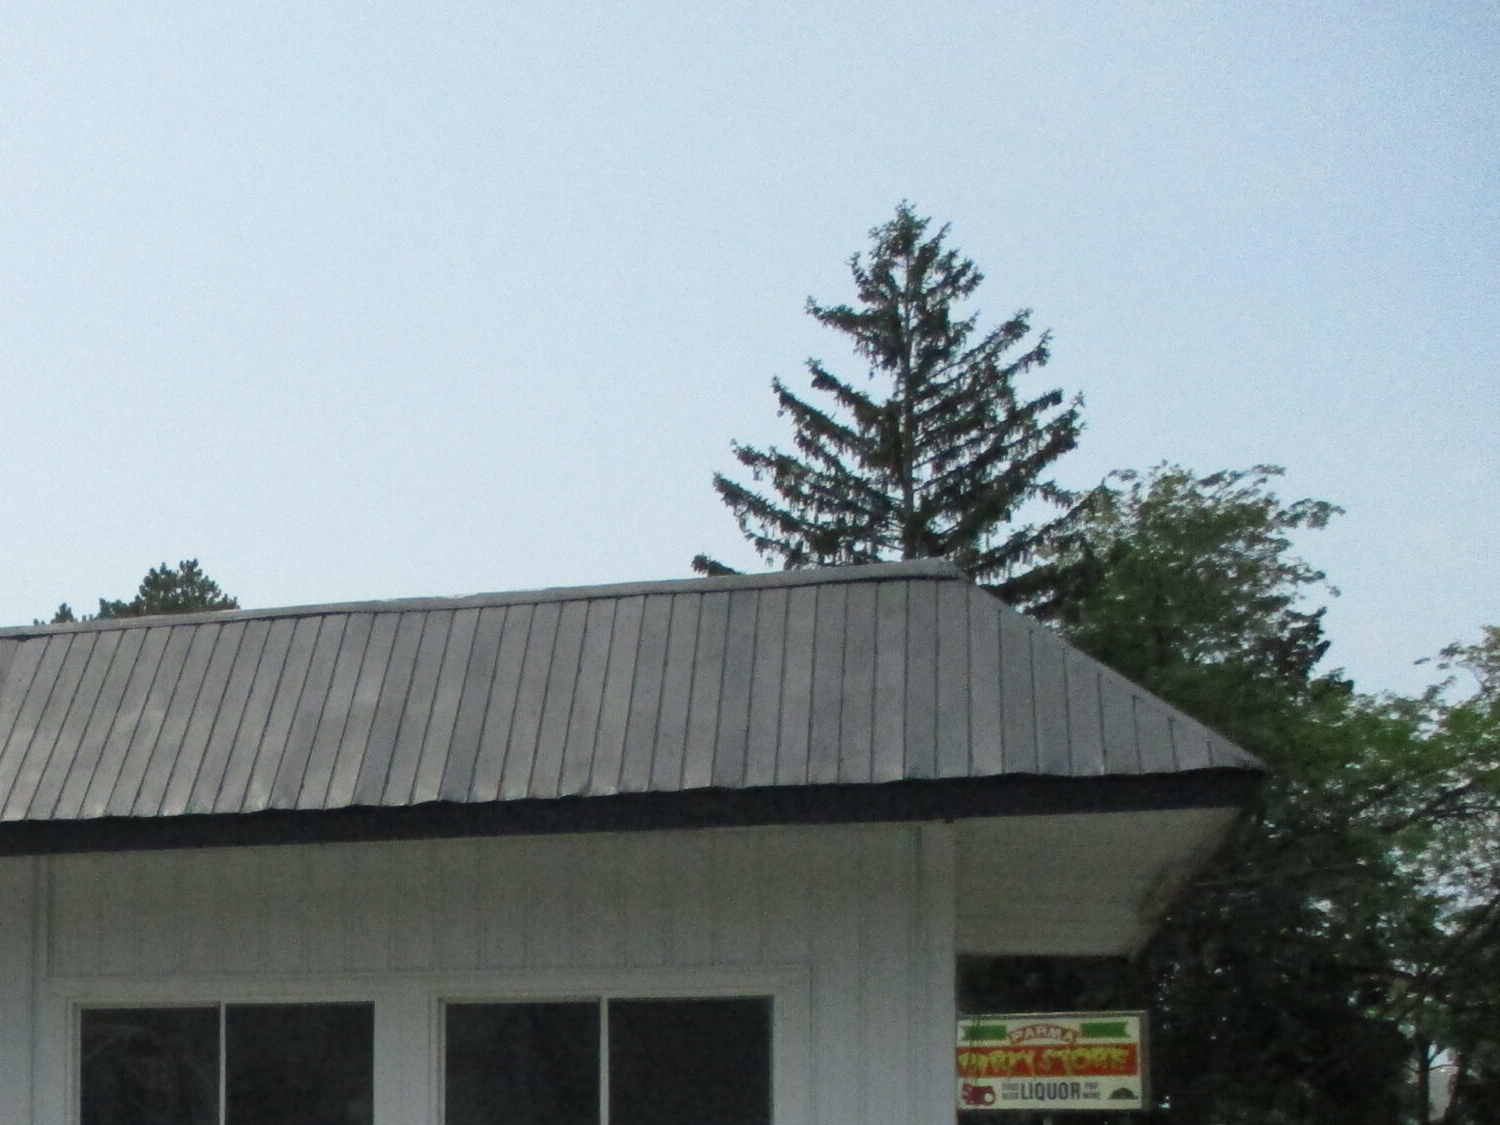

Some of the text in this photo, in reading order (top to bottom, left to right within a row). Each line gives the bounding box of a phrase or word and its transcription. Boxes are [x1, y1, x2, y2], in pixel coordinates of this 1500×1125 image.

[1011, 1025, 1076, 1042] PARMA
[1042, 1047, 1129, 1076] STORE
[1020, 1082, 1081, 1100] LIQUOR
